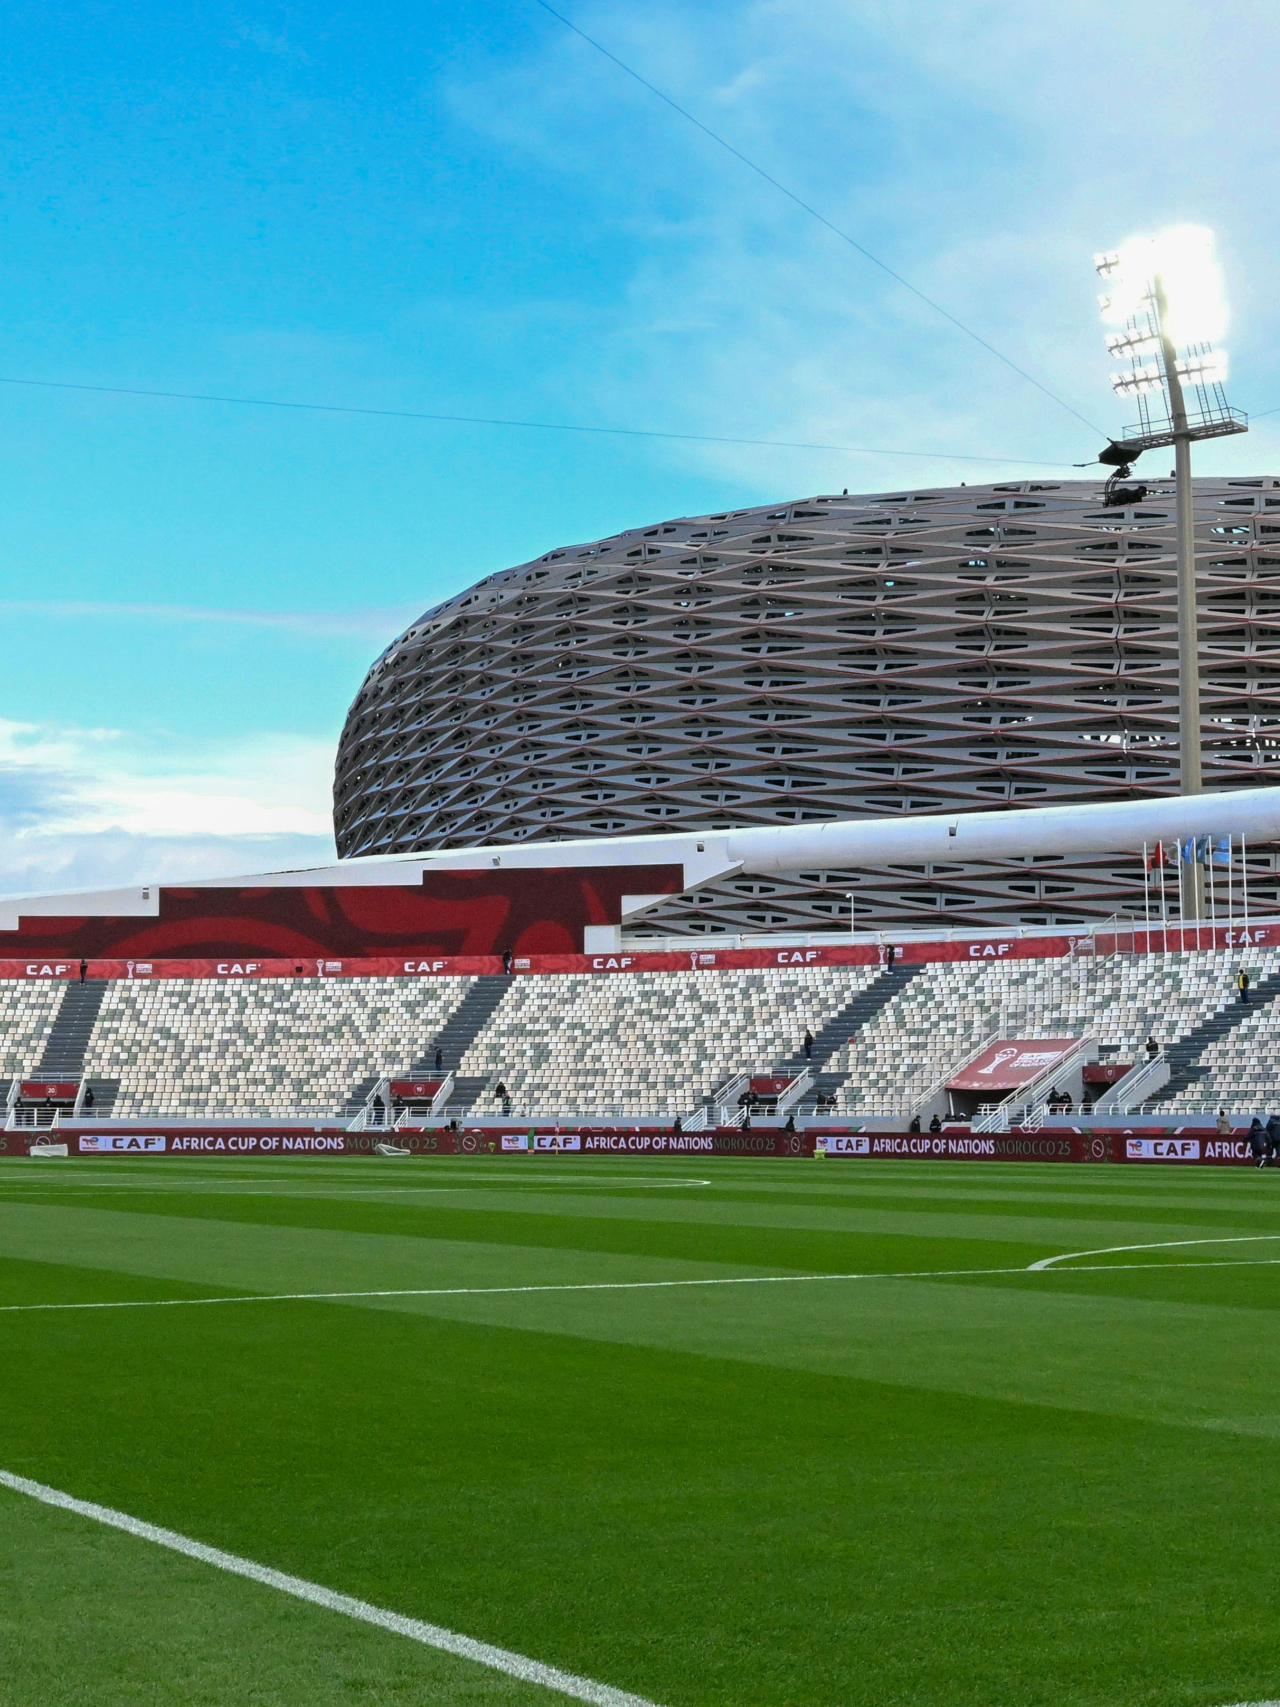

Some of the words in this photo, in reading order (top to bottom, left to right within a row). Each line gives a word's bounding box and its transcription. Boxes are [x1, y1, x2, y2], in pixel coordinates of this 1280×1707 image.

[1225, 931, 1266, 944] CAF
[969, 946, 1008, 957] CAF
[593, 957, 632, 968] CAF
[777, 952, 817, 963] CAF
[26, 965, 67, 975] CAF
[217, 964, 257, 974] CAF
[404, 961, 444, 972] CAF
[112, 1138, 156, 1149] CAF
[171, 1137, 226, 1150] AFRICA
[228, 1137, 257, 1150] CUP
[260, 1137, 280, 1150] OF
[282, 1137, 344, 1150] NATIONS
[423, 1138, 438, 1150] 25
[537, 1137, 572, 1149] CAF
[585, 1136, 627, 1149] AFRICA
[628, 1136, 650, 1149] CUP
[652, 1136, 667, 1149] OF
[669, 1136, 713, 1149] NATIONS
[714, 1137, 764, 1150] MOROCCO
[765, 1138, 776, 1150] 25
[836, 1139, 864, 1151] CAF
[873, 1138, 909, 1152] AFRICA
[910, 1138, 931, 1153] CUP
[932, 1139, 946, 1153] OF
[948, 1139, 995, 1154] NATIONS
[996, 1140, 1055, 1155] MOROCCO
[1058, 1141, 1071, 1155] 25
[1153, 1142, 1191, 1156] CAF
[1204, 1142, 1253, 1158] AFRICA
